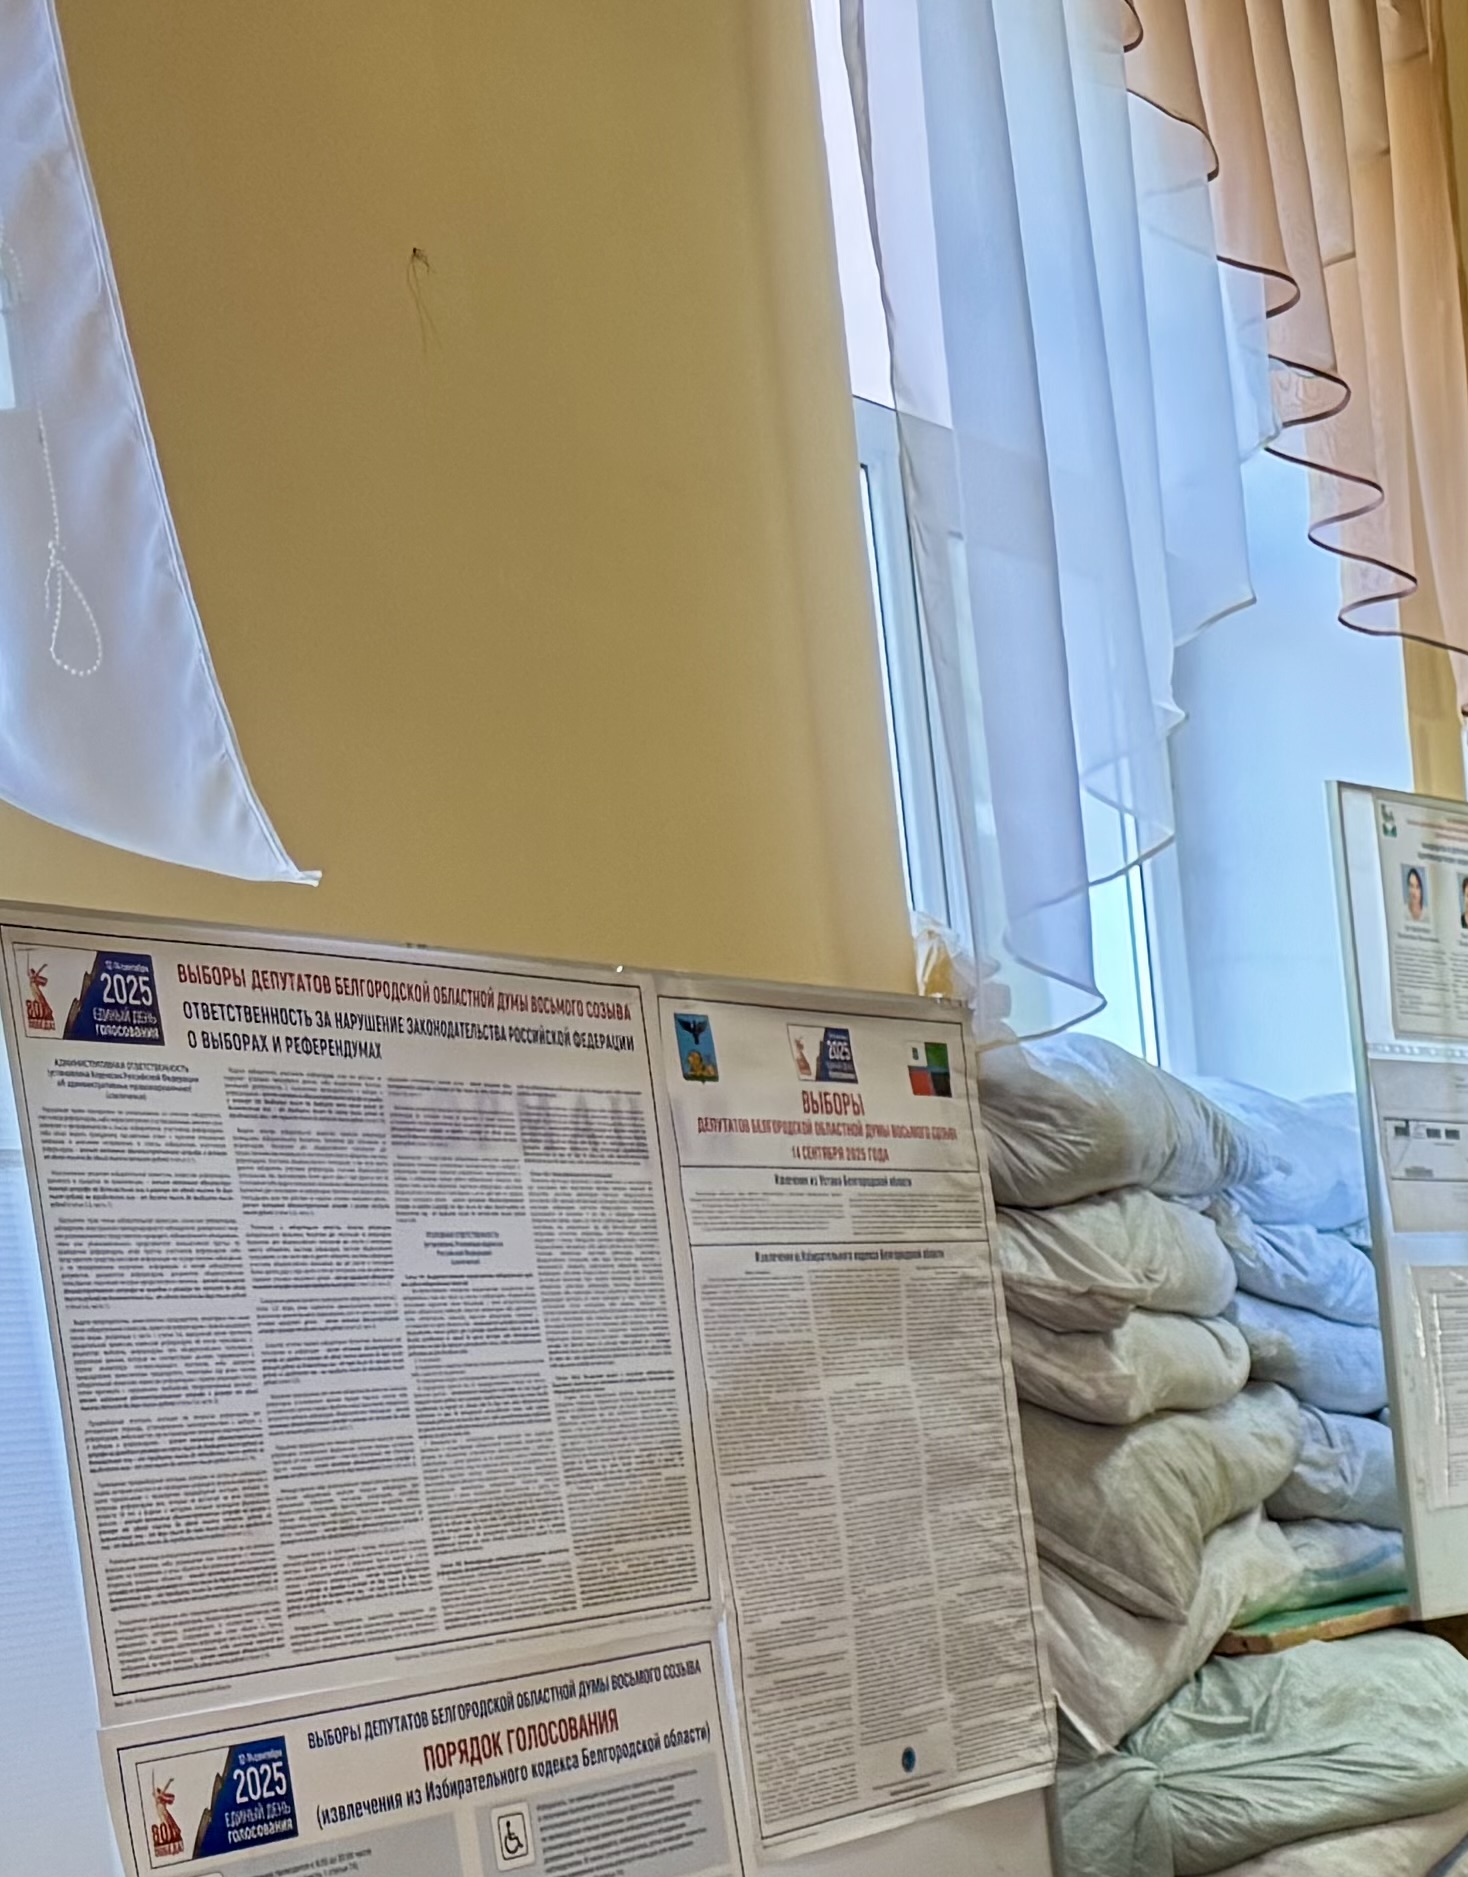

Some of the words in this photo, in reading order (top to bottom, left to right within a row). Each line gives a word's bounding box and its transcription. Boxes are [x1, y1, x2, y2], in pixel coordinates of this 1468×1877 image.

[100, 972, 153, 1006] 2025
[177, 963, 246, 987] ВЫБОРЫ
[251, 968, 331, 995] ДЕПУТАТОВ
[334, 975, 431, 1003] БЕЛГОРОДСКОЙ
[433, 985, 495, 1010] ОБЛАСТНОЙ
[497, 991, 528, 1012] ДУМЫ
[531, 995, 584, 1017] ВОСЬМОГО
[586, 1000, 632, 1021] СОЗЫВА
[183, 1000, 312, 1027] ОТВЕТСТВЕННОСТЬ
[315, 1011, 333, 1028] ЗА
[335, 1011, 404, 1034] НАРУШЕНИЕ
[406, 1020, 507, 1042] ЗАКОНОДАТЕЛЬСТВА
[509, 1025, 571, 1048] РОССИЙСКОЙ
[573, 1031, 635, 1053] ФЕДЕРАЦИИ
[188, 1030, 197, 1049] О
[203, 1032, 269, 1053] ВЫБОРАХ
[272, 1037, 281, 1053] И
[285, 1037, 383, 1060] РЕФЕРЕНДУМАХ
[802, 1090, 865, 1116] ВЫБОРЫ
[698, 1117, 750, 1134] ДЕПУТАТОВ
[815, 1120, 864, 1138] ОБЛАСТНОЙ
[803, 1146, 844, 1161] СЕНТЯБРЯ
[846, 1147, 866, 1161] 2025
[868, 1148, 889, 1162] ГОДА
[308, 1722, 361, 1749] ВЫБОРЫ
[365, 1711, 429, 1741] ДЕПУТАТОВ
[432, 1694, 515, 1726] БЕЛГОРОДСКОЙ
[517, 1679, 577, 1709] ОБЛАСТНОЙ
[579, 1674, 610, 1700] ДУМЫ
[612, 1665, 661, 1692] ВОСЬМОГО
[663, 1659, 702, 1683] СОЗЫВА
[423, 1732, 503, 1772] ПОРЯДОК
[508, 1708, 620, 1753] ГОЛОСОВАНИЯ
[233, 1761, 287, 1804] 2025
[316, 1796, 403, 1830] (извлечения
[406, 1788, 422, 1806] из
[425, 1767, 529, 1803] Избирательного
[531, 1751, 579, 1780] кодекса
[582, 1733, 661, 1767] Белгородской
[664, 1720, 711, 1750] области)
[225, 1803, 266, 1827] ЕДИНЫЙ
[267, 1800, 291, 1819] ДЕНЬ
